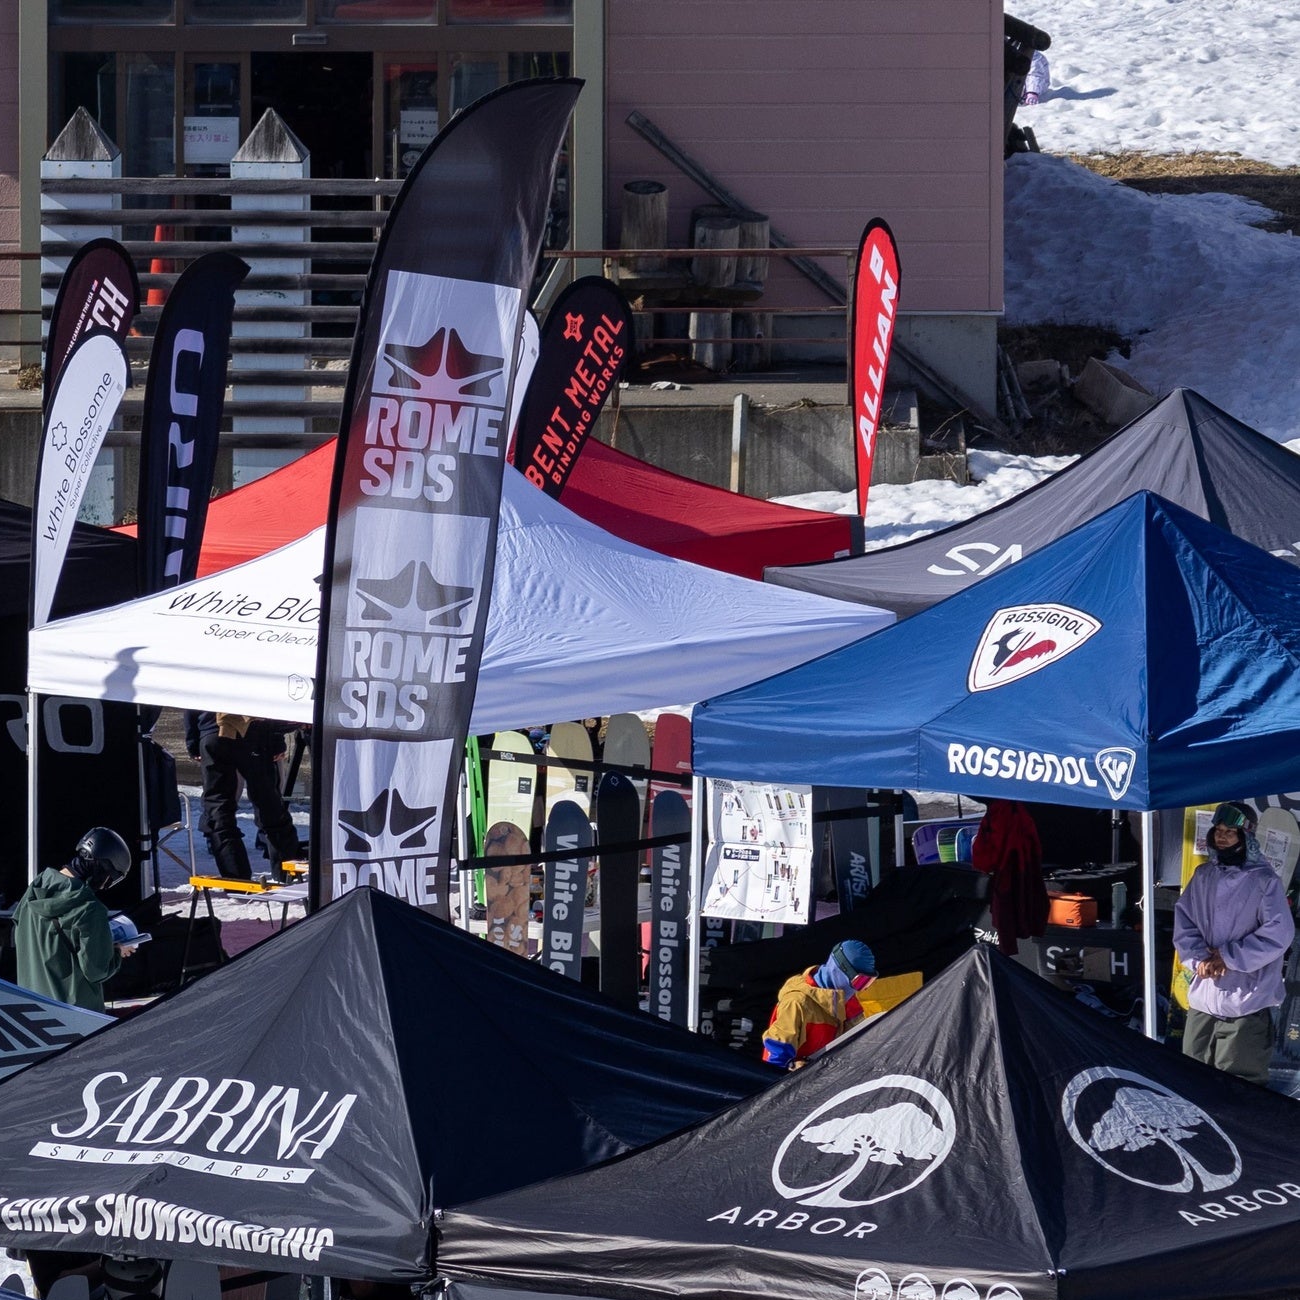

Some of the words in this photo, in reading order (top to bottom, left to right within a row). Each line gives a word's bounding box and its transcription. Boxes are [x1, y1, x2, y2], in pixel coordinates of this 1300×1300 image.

[859, 267, 899, 458] ALLIAN
[365, 396, 505, 457] ROME
[524, 406, 571, 491] BENT
[564, 313, 624, 409] METAL
[552, 410, 592, 485] BINDING
[587, 346, 624, 406] WORKS
[43, 476, 71, 542] White
[64, 372, 113, 472] Blossome
[69, 474, 85, 510] Super
[80, 424, 103, 478] Collective
[359, 448, 456, 503] SDS
[168, 590, 262, 619] White
[204, 623, 254, 641] Super
[1003, 611, 1084, 635] ROSSIGNOL
[341, 630, 472, 684] ROME
[338, 680, 429, 731] SDS
[947, 743, 1097, 788] ROSSIGNOL
[552, 833, 579, 921] White
[50, 1071, 357, 1161] SABRINA
[49, 1144, 295, 1181] SNOWBOARDS
[1, 1194, 88, 1234] GIRLS
[94, 1193, 334, 1261] SNOWBOARDING
[707, 1205, 878, 1240] ARBOR
